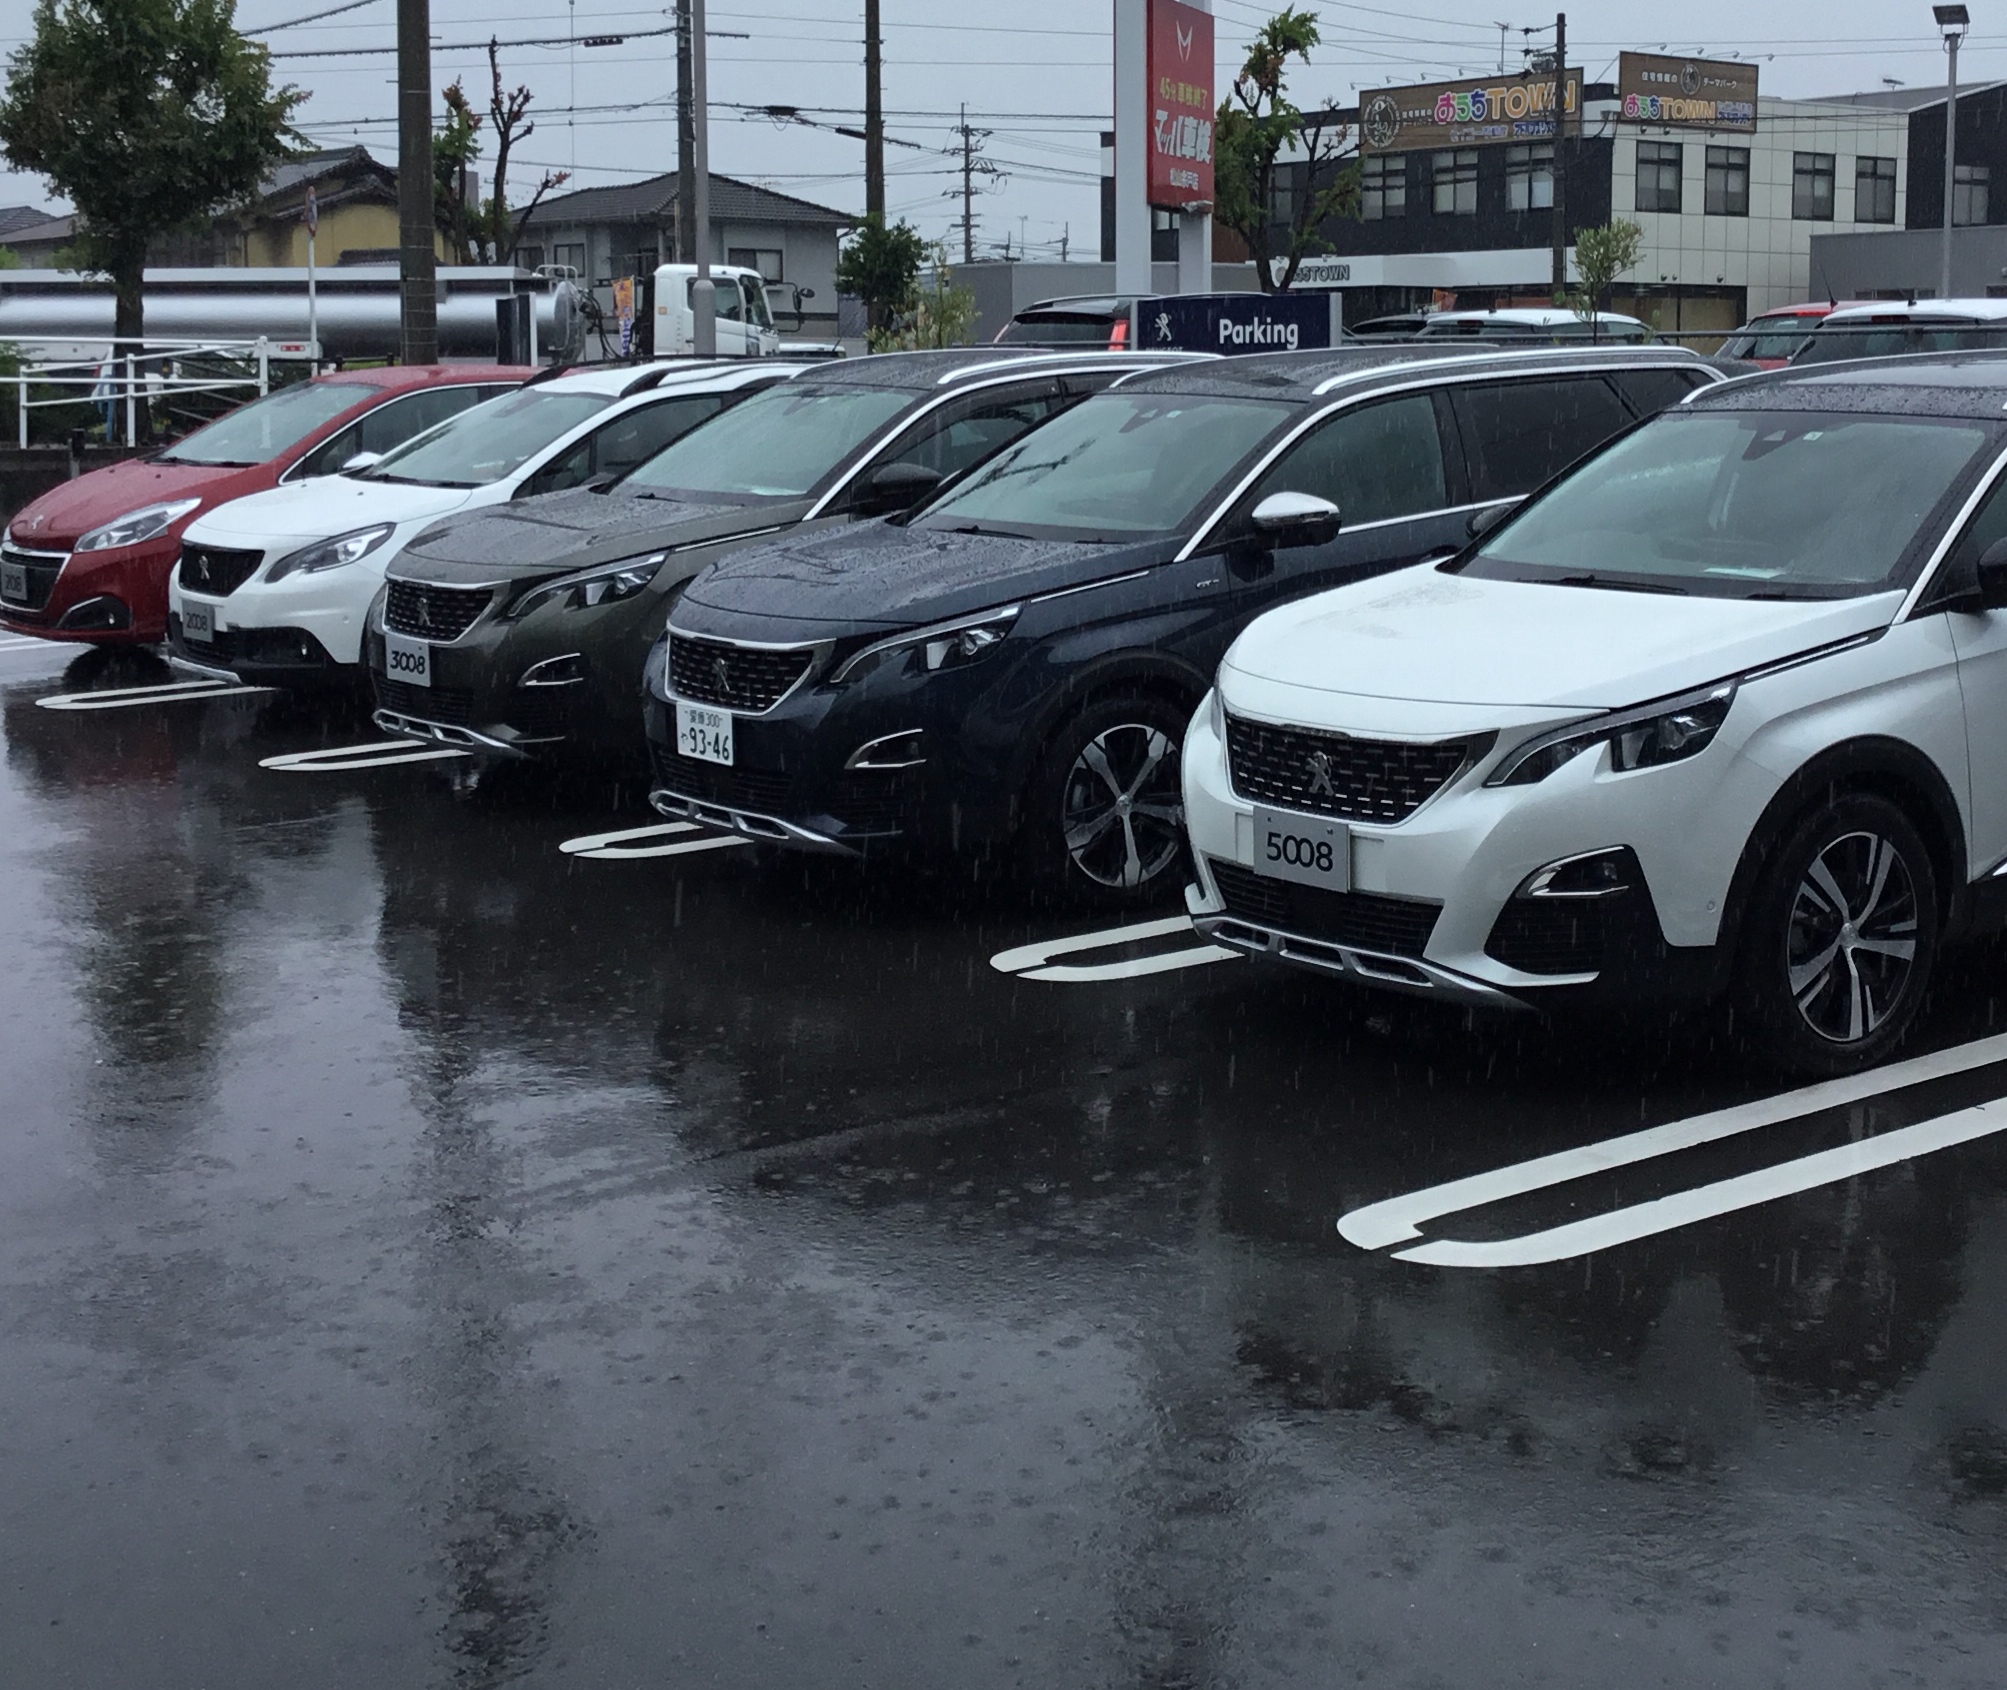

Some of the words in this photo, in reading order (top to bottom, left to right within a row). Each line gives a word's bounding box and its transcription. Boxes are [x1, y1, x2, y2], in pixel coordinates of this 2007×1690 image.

[1218, 316, 1299, 350] Parking
[390, 650, 426, 675] 3008
[689, 726, 730, 761] 93-46
[1266, 831, 1334, 873] 5008
